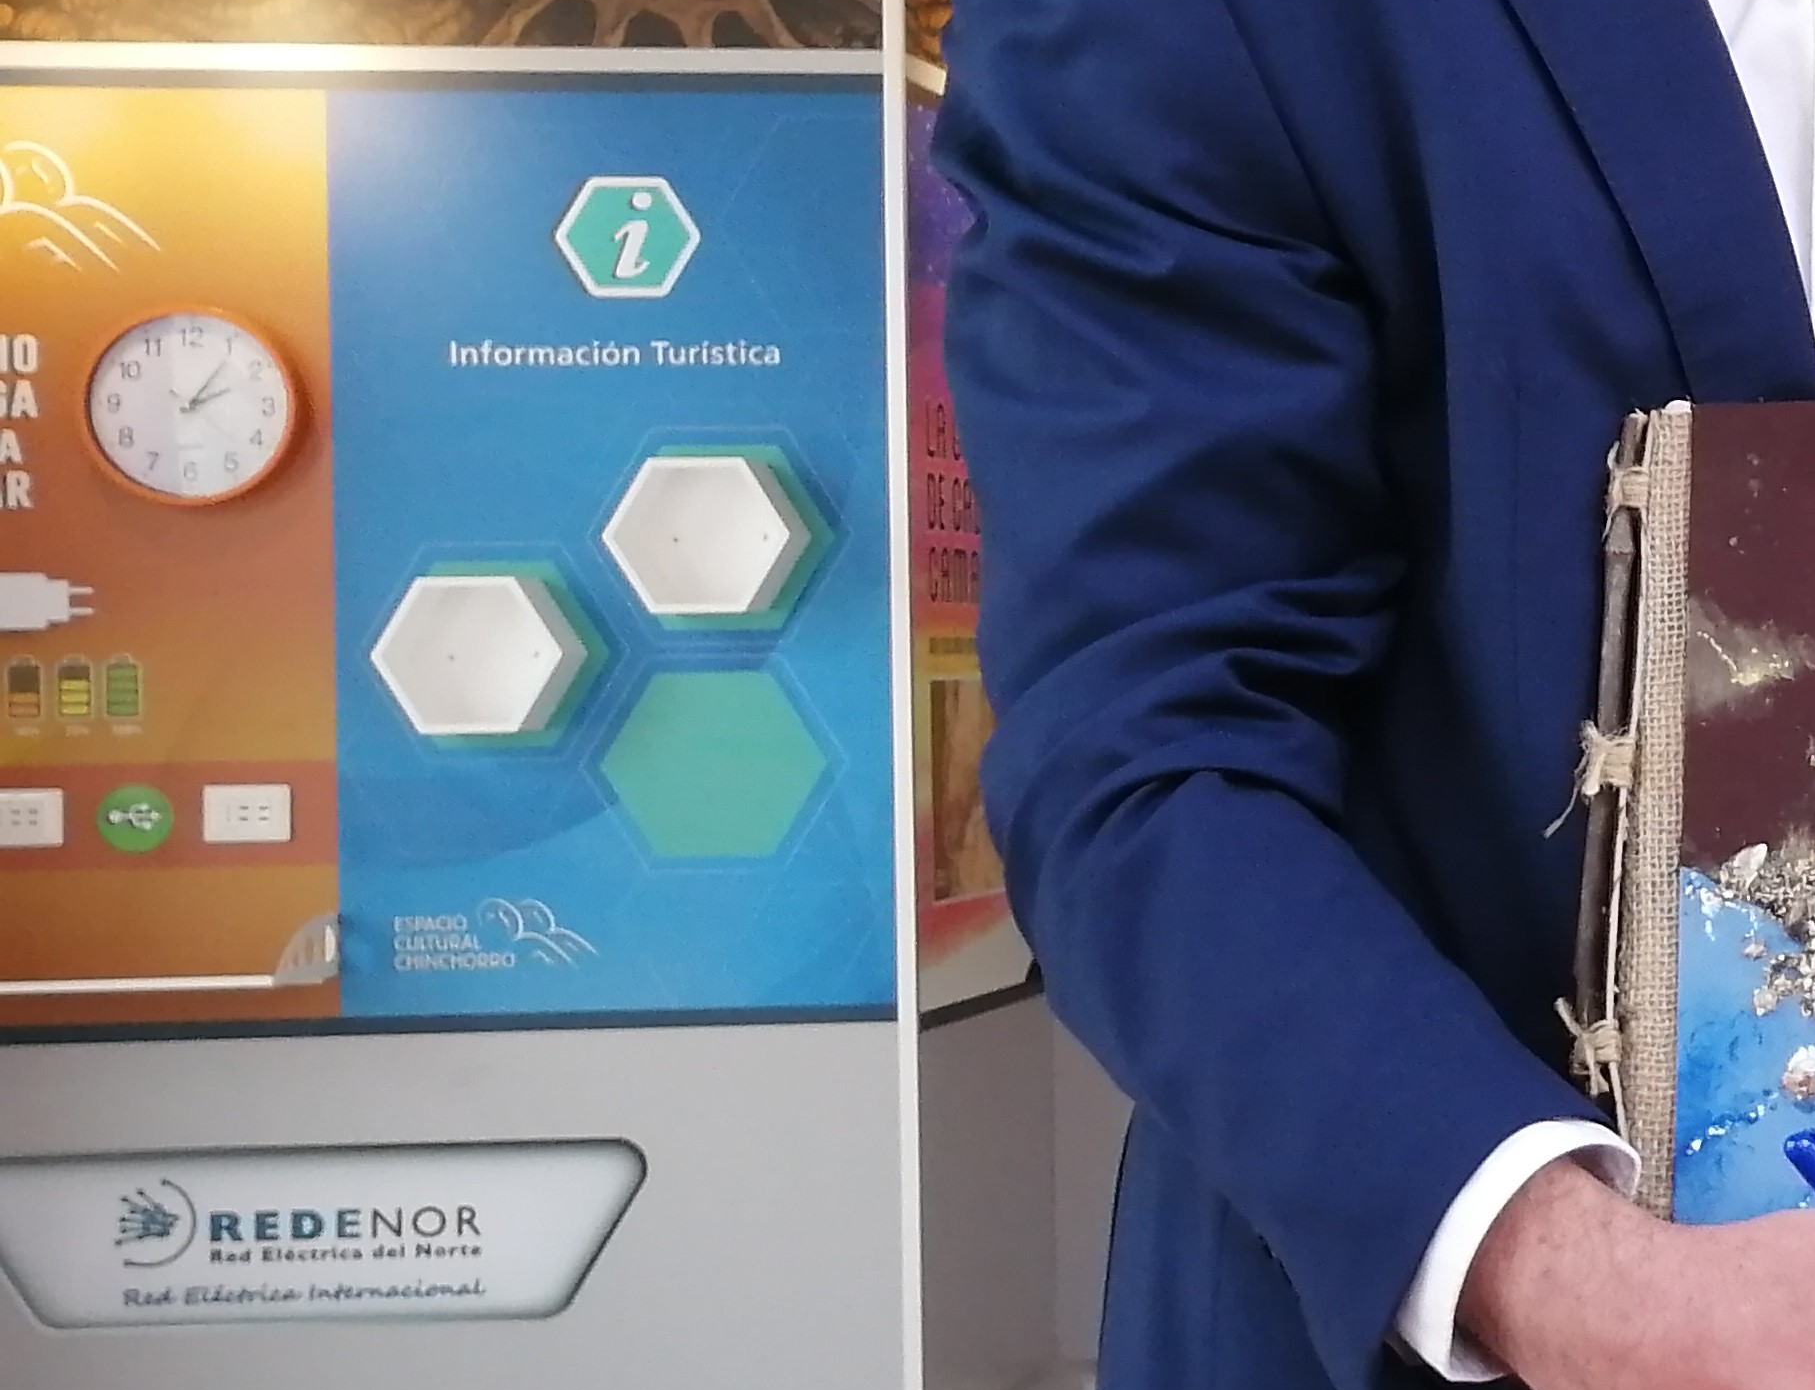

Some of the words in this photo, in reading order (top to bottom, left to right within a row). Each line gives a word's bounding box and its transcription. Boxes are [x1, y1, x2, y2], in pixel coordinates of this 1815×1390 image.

[449, 338, 641, 367] Información
[649, 338, 781, 367] Turística
[209, 1205, 482, 1243] REDENOR
